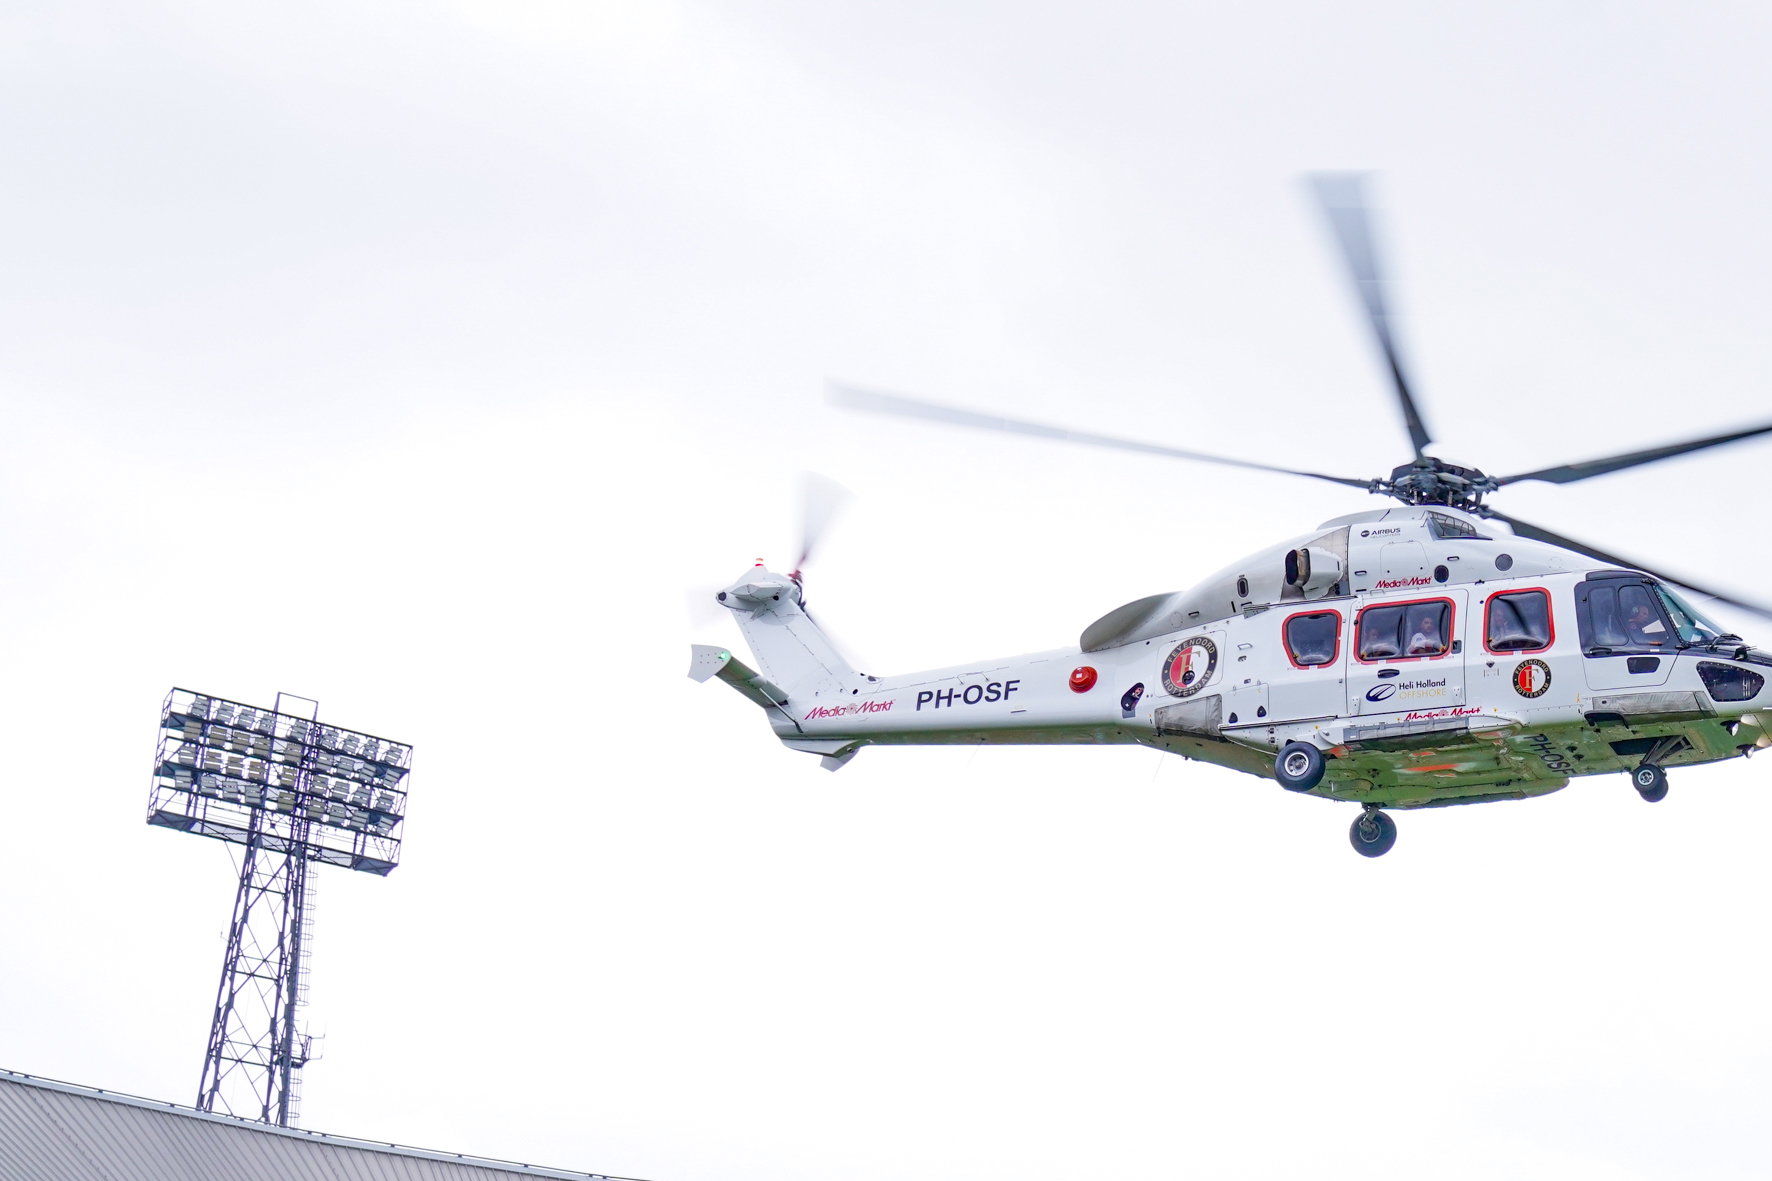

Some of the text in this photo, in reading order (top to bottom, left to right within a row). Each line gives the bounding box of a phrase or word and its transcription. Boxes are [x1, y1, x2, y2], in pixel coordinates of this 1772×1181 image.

[1371, 527, 1401, 536] AIRBUS
[1375, 577, 1431, 588] Media Markt
[1168, 637, 1216, 662] FEYENOORD
[1514, 658, 1550, 675] FEYENOORD
[1163, 669, 1213, 697] ROTTERDAM
[1399, 678, 1446, 690] Heli Holland
[1514, 681, 1550, 699] ROTTERDAM
[916, 679, 1021, 711] PH-OSF
[1400, 689, 1447, 701] OFFSHORE
[804, 699, 894, 721] Media Markt
[1523, 734, 1577, 775] PH-OSF
